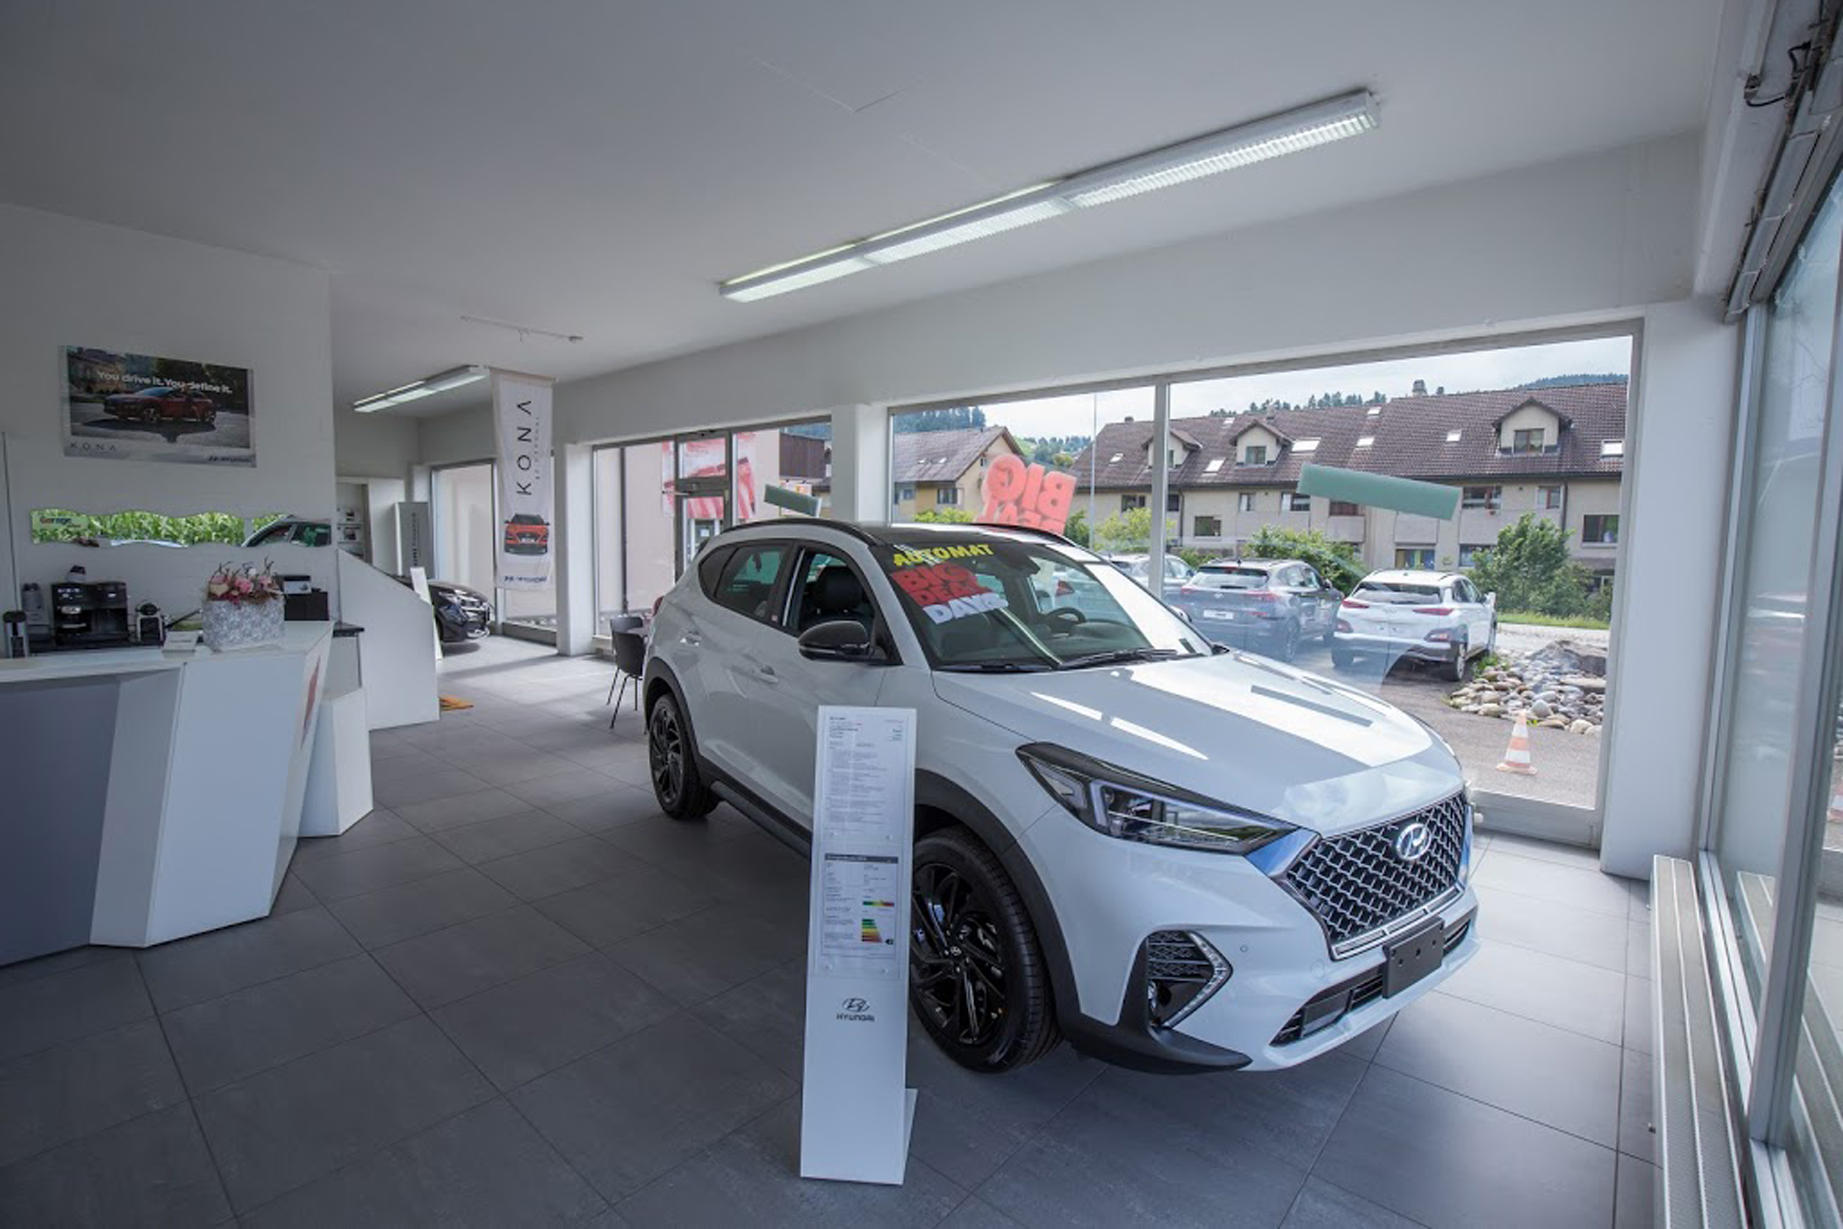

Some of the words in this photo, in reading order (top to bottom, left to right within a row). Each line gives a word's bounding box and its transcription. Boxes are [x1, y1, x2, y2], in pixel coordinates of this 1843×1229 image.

[98, 371, 120, 381] You
[122, 374, 151, 384] drive
[164, 378, 185, 389] You
[516, 400, 532, 496] KONA
[892, 544, 995, 566] AUTOMAT
